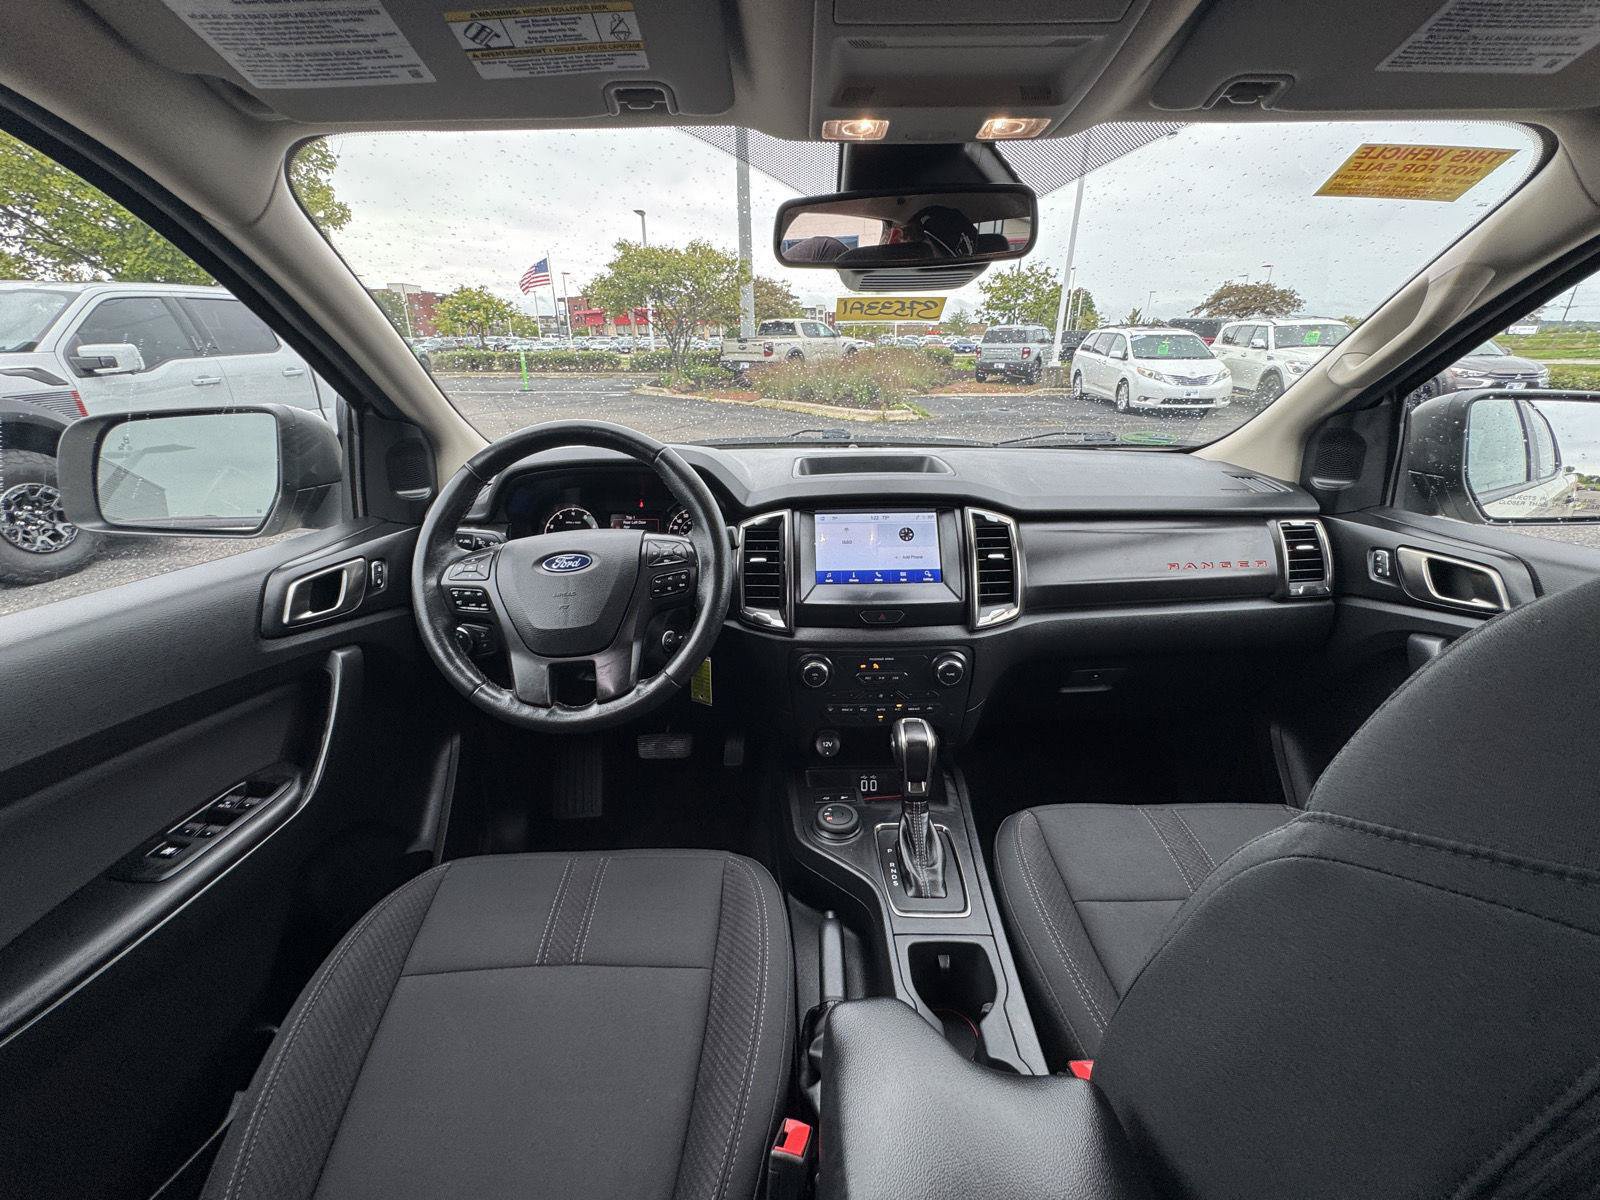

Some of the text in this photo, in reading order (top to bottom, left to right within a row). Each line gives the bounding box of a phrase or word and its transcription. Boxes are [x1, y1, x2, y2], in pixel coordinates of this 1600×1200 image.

[552, 5, 590, 13] ROLLOVER
[552, 555, 580, 570] Ford
[1167, 560, 1269, 571] RANGER
